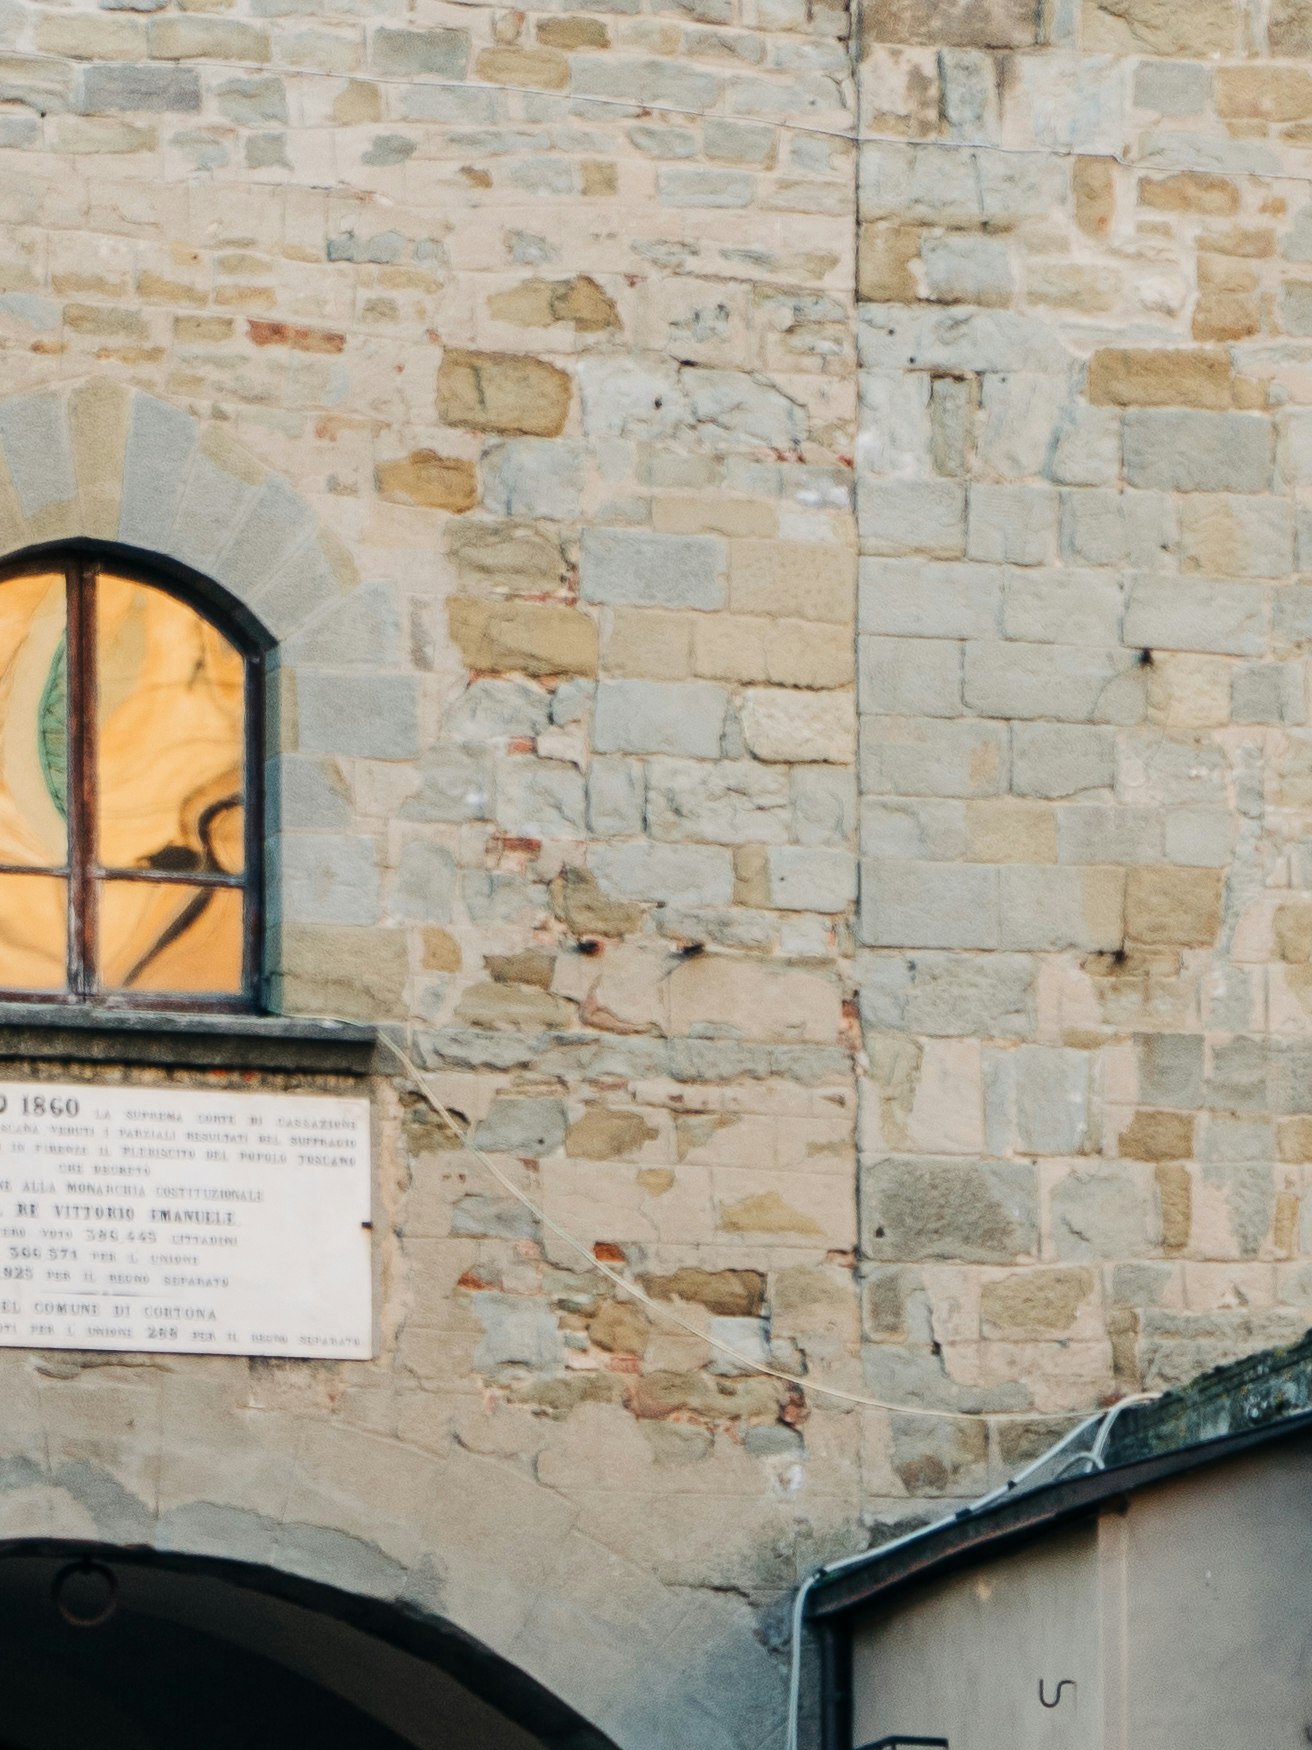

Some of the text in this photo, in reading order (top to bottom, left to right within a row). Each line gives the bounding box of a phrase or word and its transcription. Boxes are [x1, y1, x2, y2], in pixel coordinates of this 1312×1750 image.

[22, 1095, 80, 1118] 1860
[23, 1178, 57, 1194] ALLA
[66, 1180, 147, 1198] MONARCHIA
[155, 1184, 264, 1202] COSTITUZIONALE
[53, 1203, 136, 1222] VITTORIO
[149, 1207, 237, 1226] EMANUELE
[33, 1301, 100, 1318] COMUNE
[112, 1303, 132, 1318] DI
[143, 1306, 218, 1322] CORTONA
